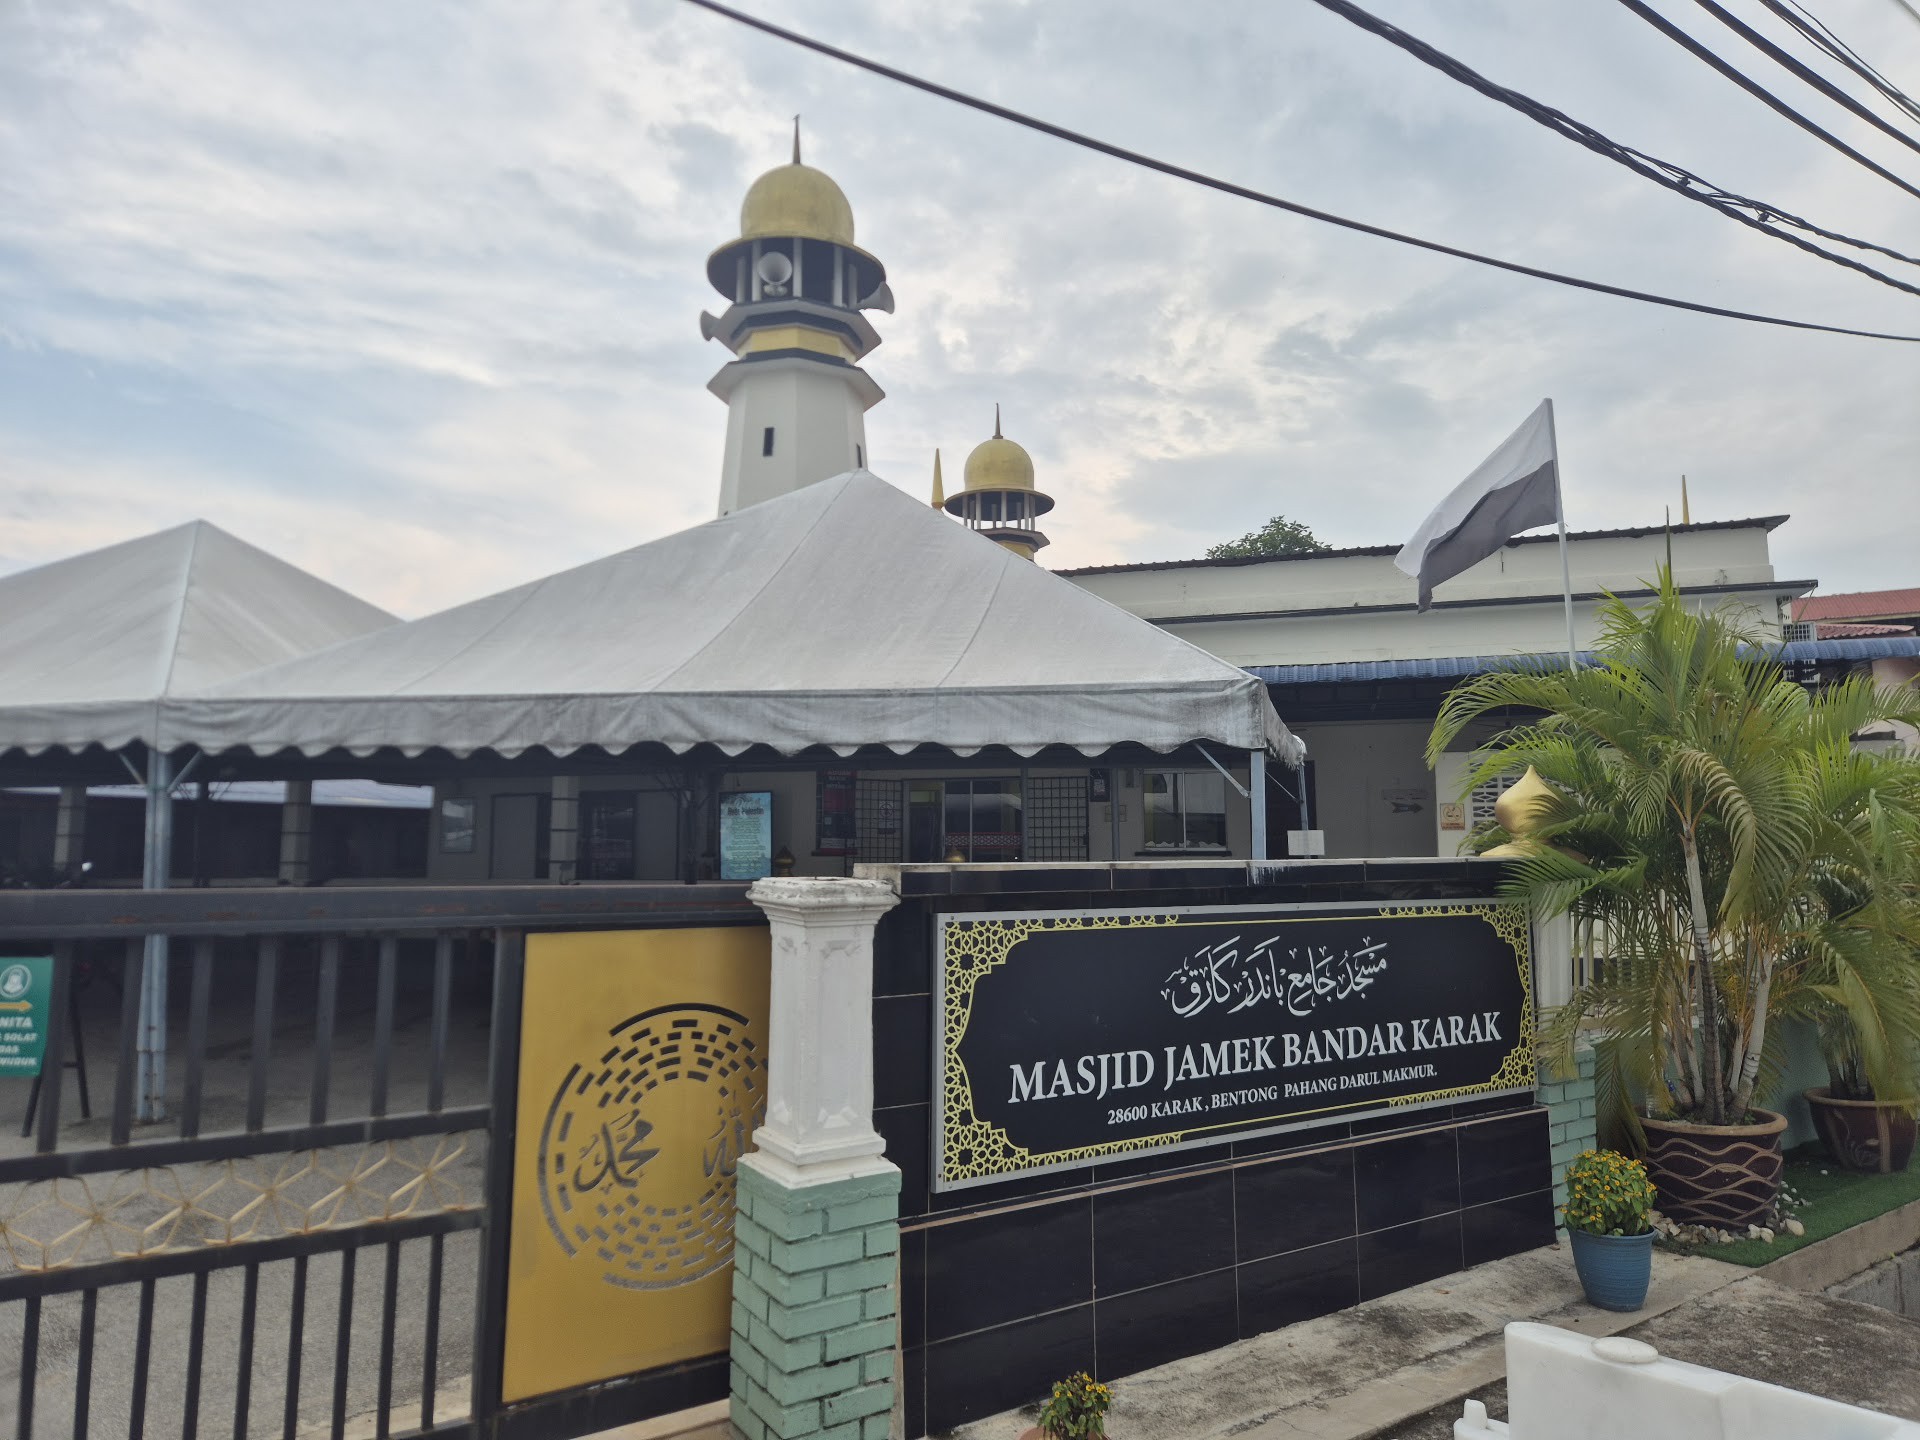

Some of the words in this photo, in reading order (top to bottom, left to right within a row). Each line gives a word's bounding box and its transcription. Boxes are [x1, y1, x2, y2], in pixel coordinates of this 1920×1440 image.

[0, 1016, 33, 1028] NITA
[1008, 1050, 1155, 1104] MASJID
[1163, 1035, 1277, 1091] JAMEK
[1282, 1021, 1407, 1068] BANDAR
[1411, 1011, 1502, 1051] KARAK
[1107, 1104, 1148, 1125] 28600
[1211, 1085, 1278, 1109] BENTONG
[1284, 1076, 1338, 1098] PAHANG
[1339, 1070, 1381, 1090] DARUL
[1382, 1063, 1438, 1084] MAKMUR.
